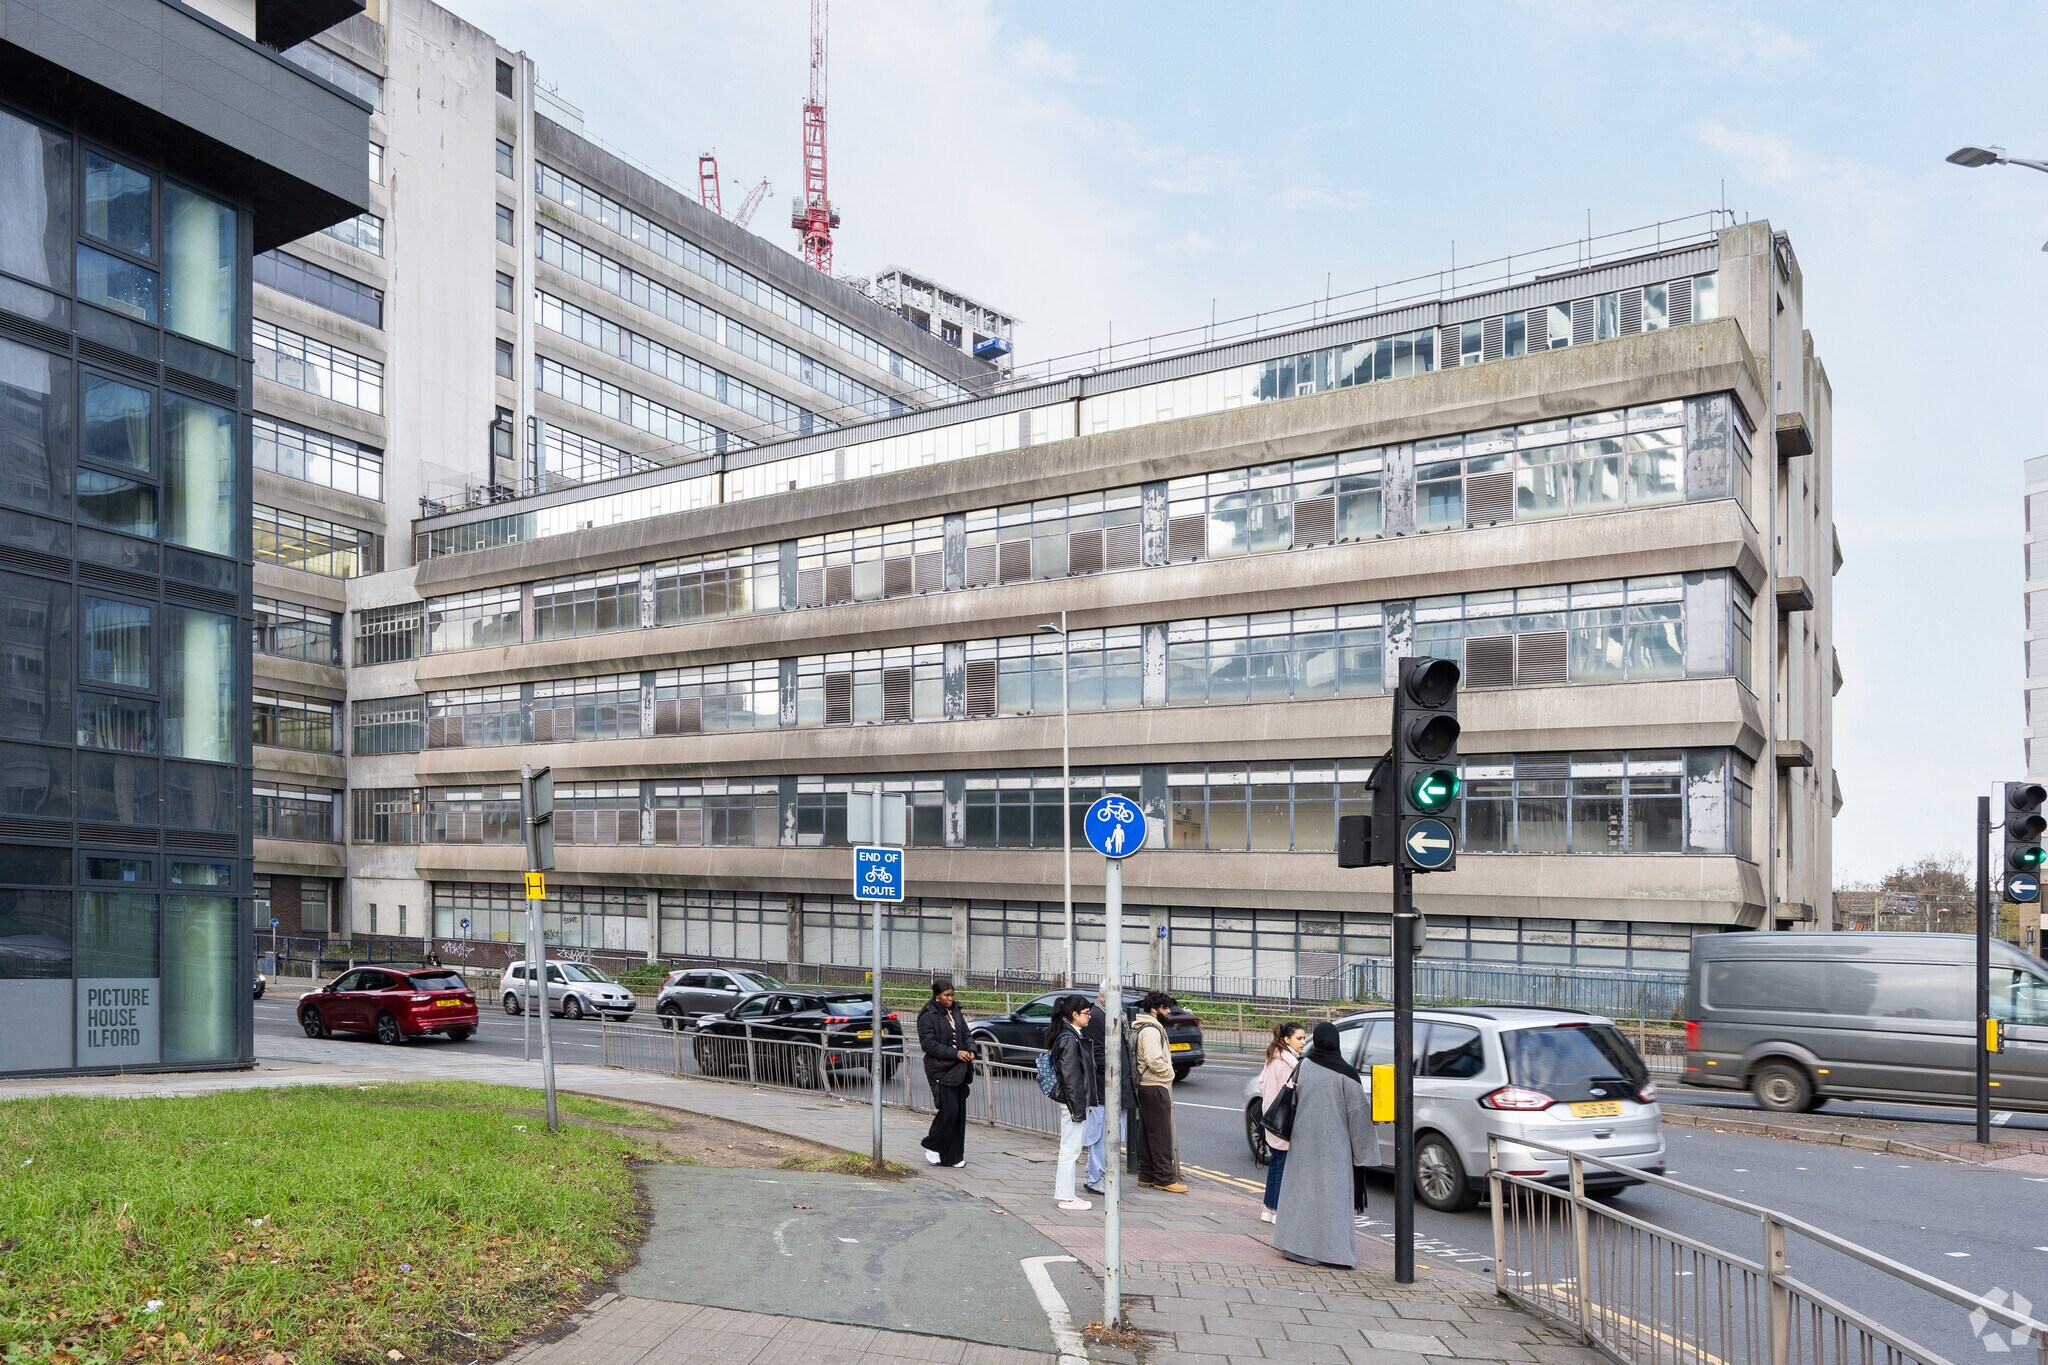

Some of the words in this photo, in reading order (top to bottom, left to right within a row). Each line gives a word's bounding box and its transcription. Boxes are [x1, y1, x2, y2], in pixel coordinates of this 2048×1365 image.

[406, 28, 443, 63] BT
[859, 852, 881, 862] END
[884, 853, 899, 863] OF
[527, 876, 543, 896] H
[862, 885, 896, 896] ROUTE
[87, 988, 150, 1007] PICTURE
[87, 1008, 138, 1028] HOUSE
[87, 1028, 141, 1048] ILFORD
